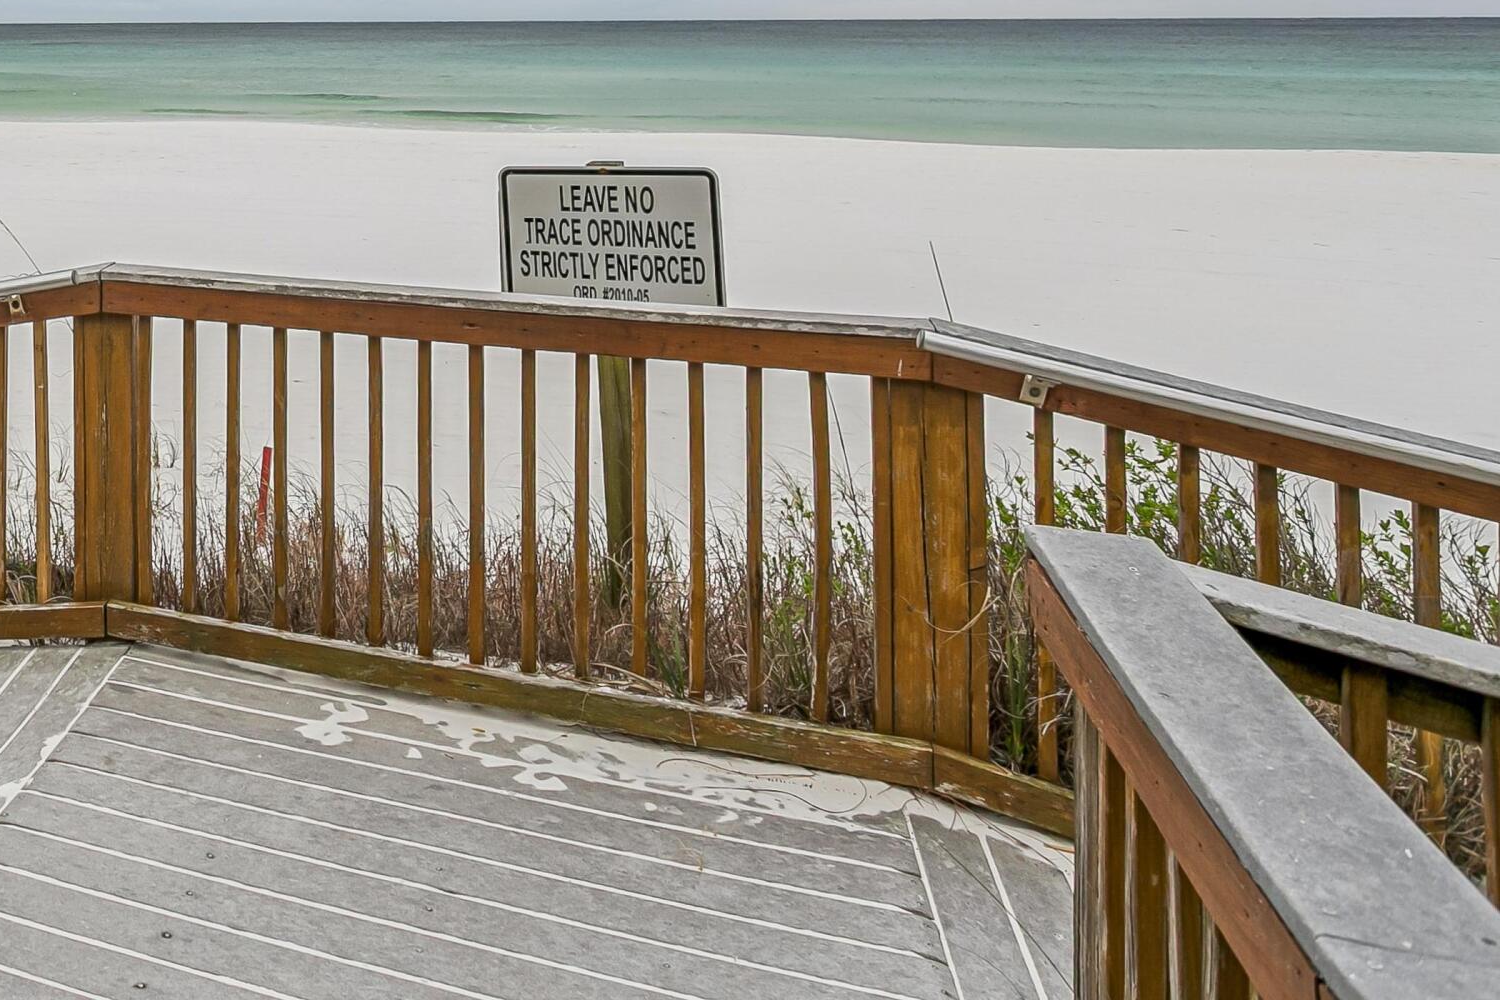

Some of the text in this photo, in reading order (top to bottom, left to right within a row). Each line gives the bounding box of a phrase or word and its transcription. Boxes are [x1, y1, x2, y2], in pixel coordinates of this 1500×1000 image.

[559, 185, 655, 214] LEAVE NO
[524, 217, 697, 250] TRACE ORDINANCE
[520, 250, 706, 285] STRICTLY ENFORCED
